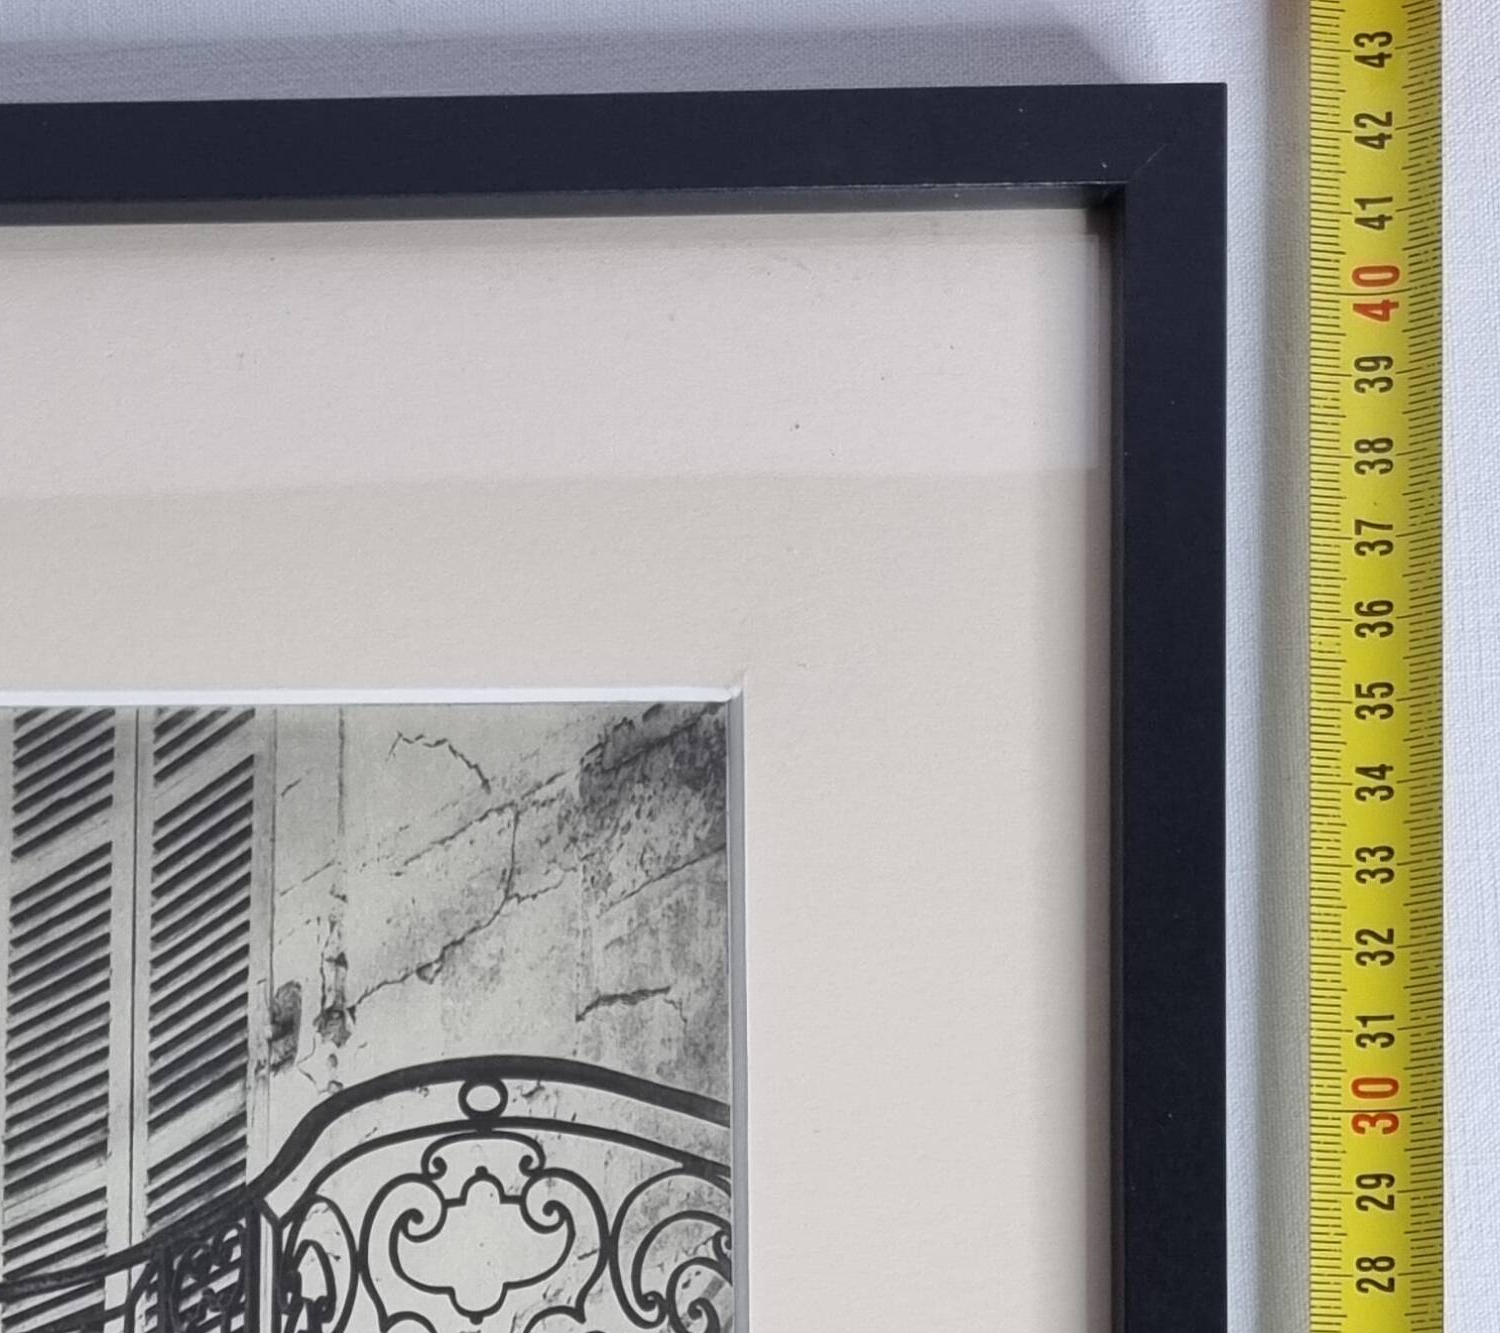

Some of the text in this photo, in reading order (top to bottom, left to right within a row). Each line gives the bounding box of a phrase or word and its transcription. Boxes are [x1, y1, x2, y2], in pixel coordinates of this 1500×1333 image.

[1353, 31, 1393, 68] 43
[1353, 111, 1393, 150] 42
[1354, 196, 1394, 231] 41
[1352, 265, 1400, 322] 40
[1354, 356, 1394, 394] 39
[1354, 437, 1394, 475] 38
[1354, 518, 1394, 557] 37
[1354, 600, 1394, 638] 36
[1354, 682, 1395, 720] 35
[1354, 764, 1395, 802] 34
[1355, 845, 1395, 884] 33
[1355, 928, 1395, 966] 32
[1355, 1014, 1395, 1048] 31
[1351, 1077, 1400, 1135] 30
[1355, 1173, 1396, 1211] 29
[1355, 1256, 1396, 1294] 28
